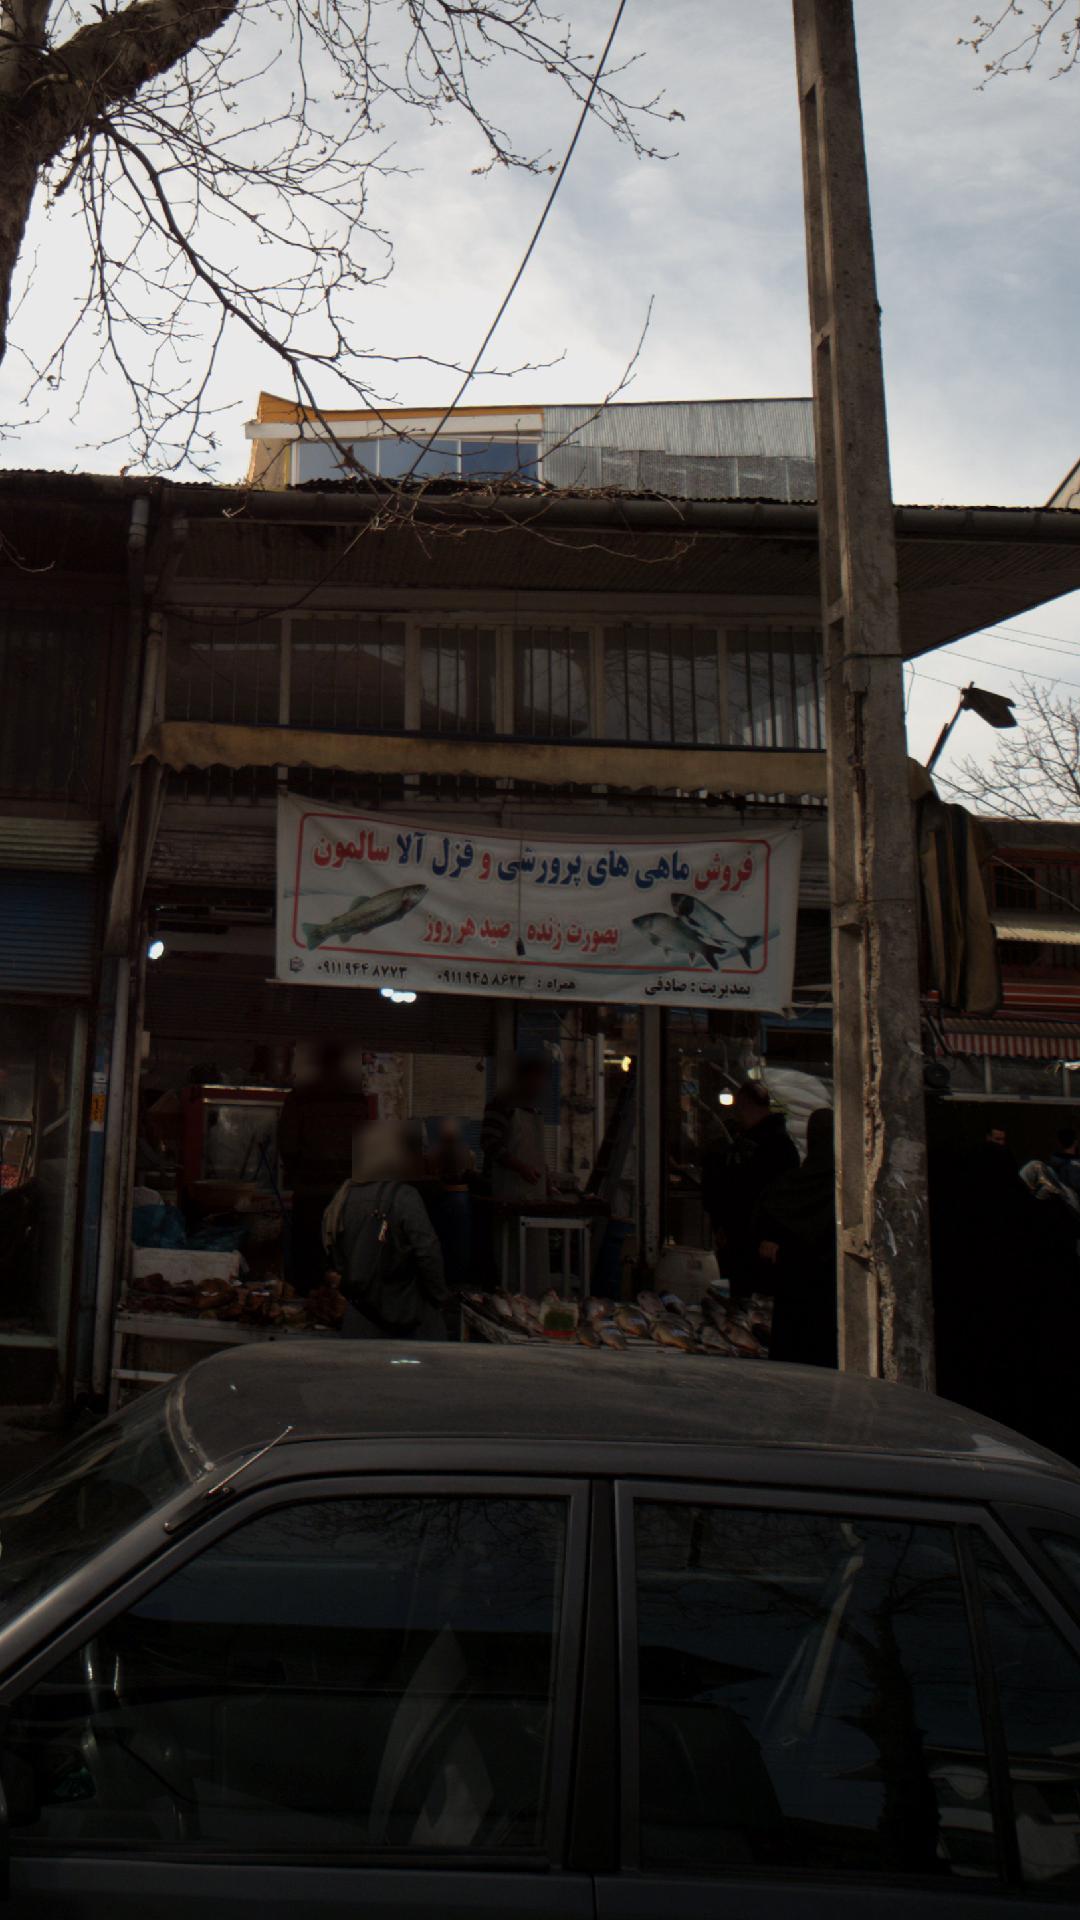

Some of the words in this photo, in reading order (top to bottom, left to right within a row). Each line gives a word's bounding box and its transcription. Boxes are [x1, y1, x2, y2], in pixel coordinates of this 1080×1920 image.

[314, 830, 390, 867] سالمون
[396, 831, 426, 865] آلا
[432, 837, 474, 878] قزل
[479, 851, 492, 880] و
[497, 847, 582, 887] پرورشی
[587, 849, 630, 887] های
[635, 850, 689, 888] ماهی
[694, 850, 753, 891] فروش
[422, 913, 452, 944] روز
[455, 916, 476, 945] هر
[480, 918, 512, 945] صید
[527, 916, 562, 951] زنده
[566, 923, 619, 952] بصورت
